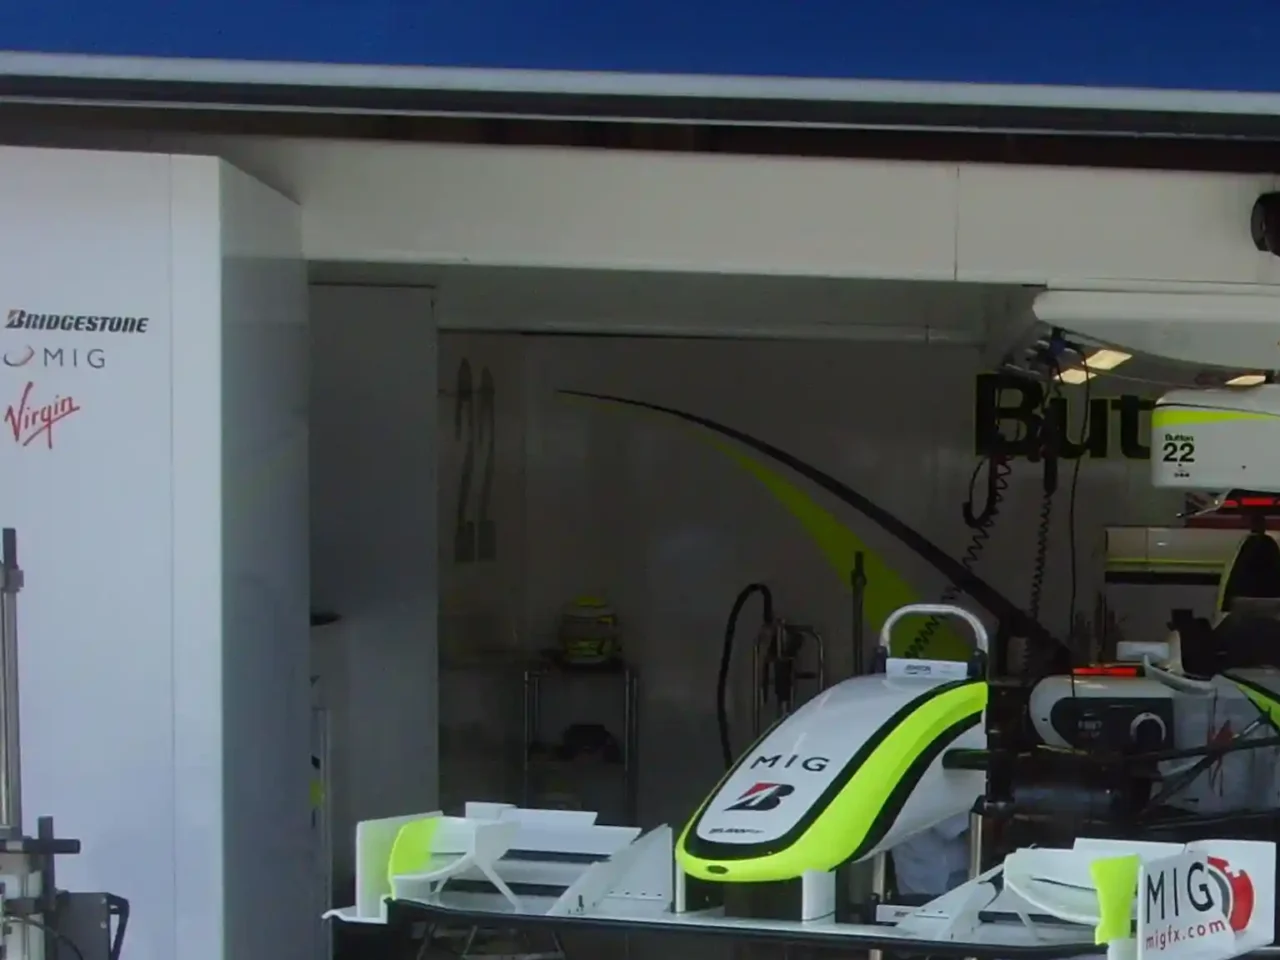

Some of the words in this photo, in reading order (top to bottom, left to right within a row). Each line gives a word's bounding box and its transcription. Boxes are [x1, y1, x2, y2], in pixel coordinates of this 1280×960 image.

[5, 309, 149, 333] BRIDGESTONE
[43, 347, 106, 369] MIG
[4, 381, 80, 449] Virgin
[1163, 442, 1195, 462] 22
[750, 754, 830, 772] MIG
[1147, 861, 1215, 924] MIG
[1145, 919, 1227, 951] migfx.com
